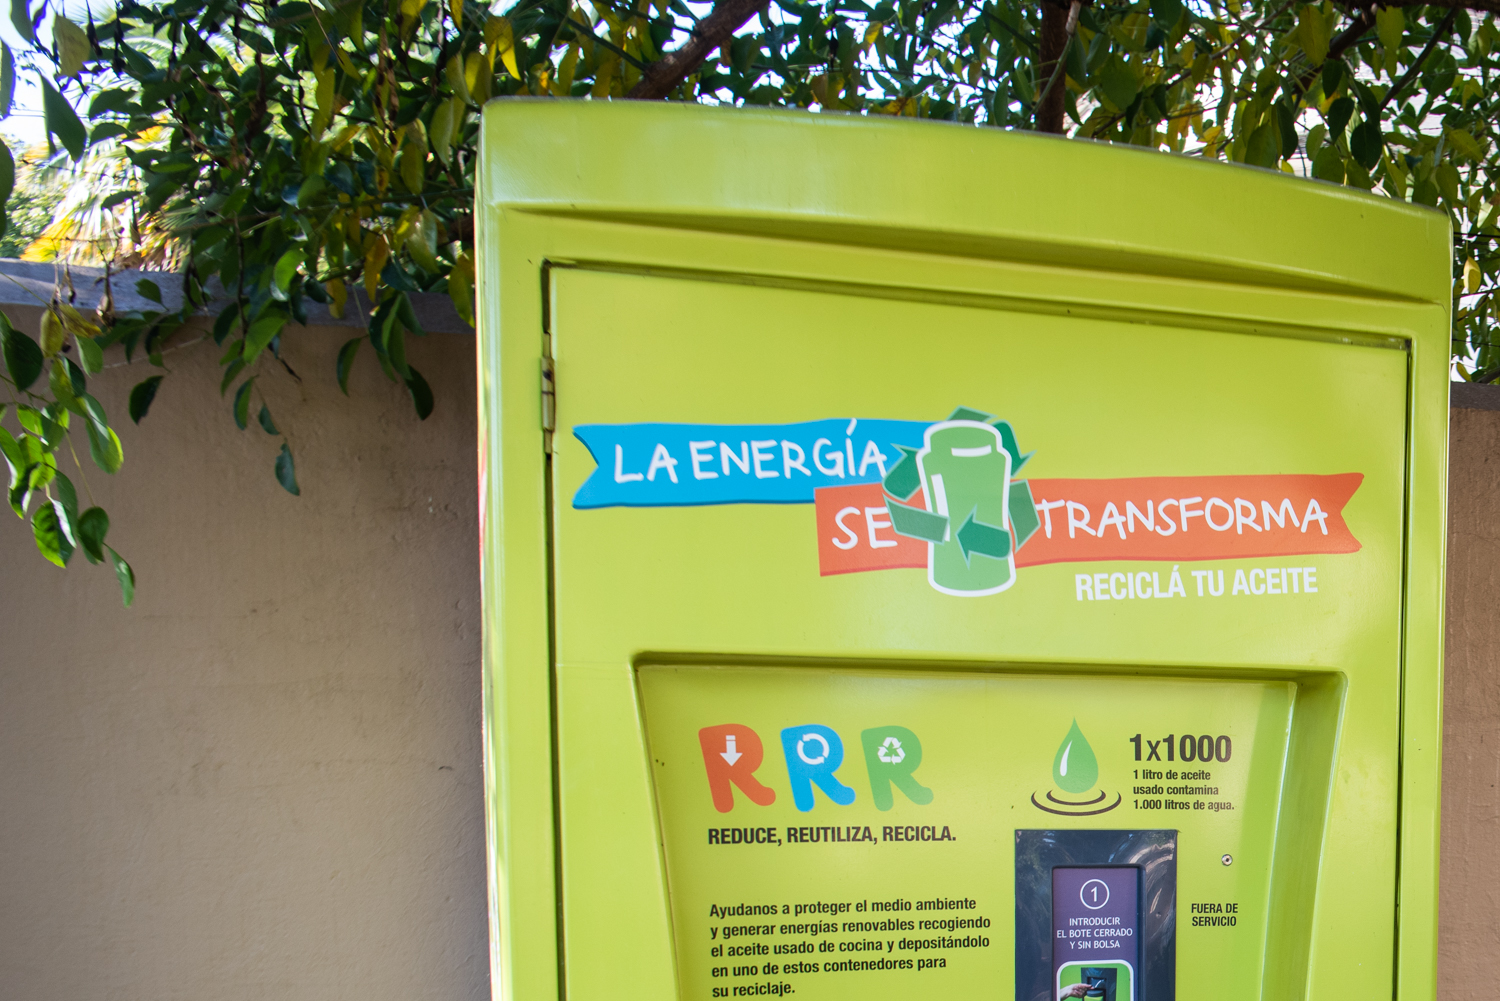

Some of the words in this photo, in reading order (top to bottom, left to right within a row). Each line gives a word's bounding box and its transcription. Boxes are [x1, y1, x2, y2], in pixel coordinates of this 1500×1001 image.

[613, 443, 678, 485] LA
[692, 417, 888, 482] ENERGÍA
[1036, 498, 1329, 541] TRANSFORMA
[832, 507, 898, 551] SE
[1075, 566, 1186, 602] RECICLÁ
[1191, 571, 1223, 598] TU
[1231, 567, 1318, 596] ACEITE
[1130, 734, 1232, 762] 1x1000
[1133, 770, 1138, 779] 1
[1142, 770, 1163, 780] litro
[1166, 770, 1178, 779] de
[1181, 770, 1211, 780] aceite
[1133, 785, 1164, 795] usado
[1167, 785, 1219, 795] contamina
[1134, 800, 1161, 809] 1.000
[1165, 800, 1190, 810] litros
[1193, 800, 1205, 810] de
[1208, 802, 1234, 812] agua.
[708, 828, 782, 847] REDUCE,
[787, 826, 878, 845] REUTILIZA,
[883, 826, 956, 841] RECICLA.
[1091, 886, 1097, 902] 1
[709, 903, 778, 919] Ayudanos
[782, 905, 790, 914] a
[794, 901, 851, 916] proteger
[856, 901, 867, 912] el
[872, 899, 912, 912] medio
[916, 897, 976, 911] ambiente
[1191, 903, 1223, 913] FUERA
[1226, 903, 1238, 913] DE
[710, 926, 718, 940] y
[722, 923, 775, 939] generar
[780, 920, 838, 936] energías
[842, 918, 915, 932] renovables
[919, 916, 991, 932] recogiendo
[1069, 917, 1120, 926] INTRODUCIR
[1192, 916, 1237, 927] SERVICIO
[1057, 930, 1067, 938] EL
[1069, 929, 1091, 938] BOTE
[1094, 928, 1133, 937] CERRADO
[711, 945, 723, 957] el
[728, 943, 769, 957] aceite
[774, 941, 814, 955] usado
[819, 940, 835, 953] de
[839, 939, 882, 952] cocina
[887, 940, 894, 952] y
[898, 935, 990, 951] depositándolo
[1078, 941, 1091, 949] SIN
[1094, 940, 1120, 948] BOLSA
[712, 966, 728, 977] en
[733, 964, 758, 977] uno
[763, 962, 779, 975] de
[783, 961, 819, 974] estos
[824, 958, 913, 972] contenedores
[917, 958, 946, 971] para
[712, 986, 728, 998] su
[733, 982, 795, 997] reciclaje.
